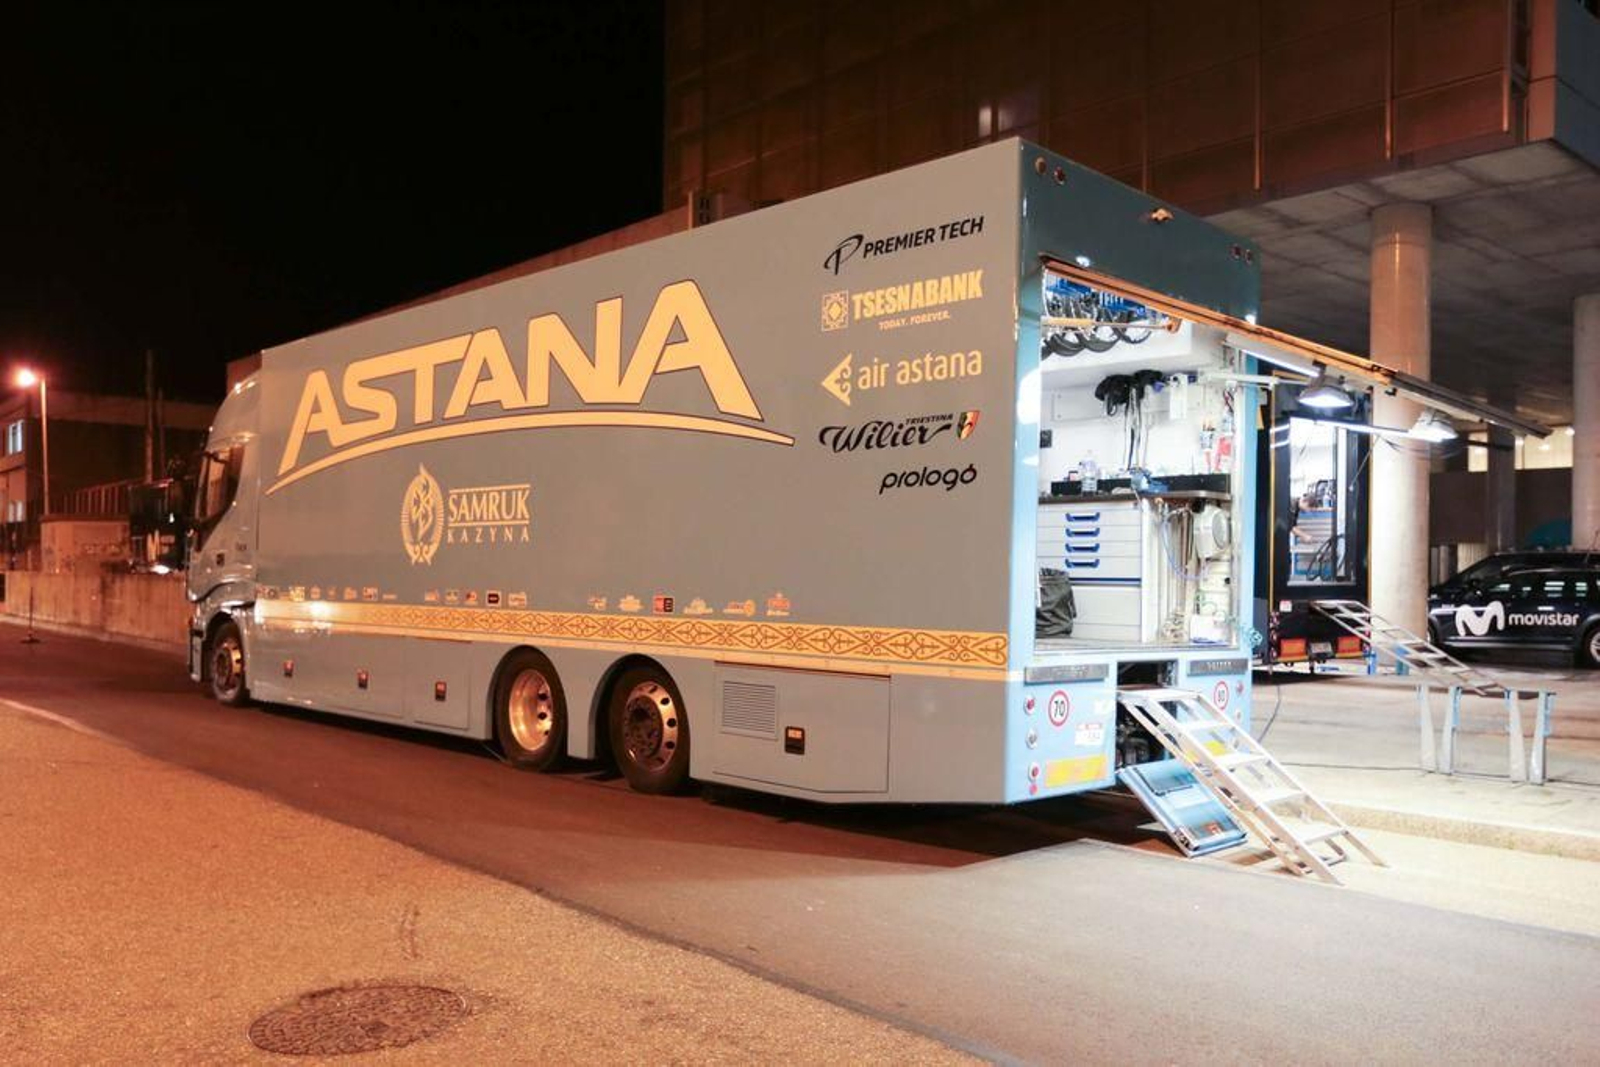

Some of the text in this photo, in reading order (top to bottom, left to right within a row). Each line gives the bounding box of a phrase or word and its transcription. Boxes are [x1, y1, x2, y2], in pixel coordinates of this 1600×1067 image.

[863, 227, 936, 259] PREMIER
[939, 216, 984, 241] TECH
[852, 270, 983, 320] TSESNABANK
[277, 279, 764, 477] ASTANA
[858, 350, 982, 390] air astana
[905, 413, 953, 425] TRIESTINA
[819, 420, 951, 453] Wilier
[449, 490, 530, 522] SAMRUK
[447, 526, 529, 544] KAZYNA
[1508, 613, 1579, 626] movistar
[1054, 700, 1066, 718] 70
